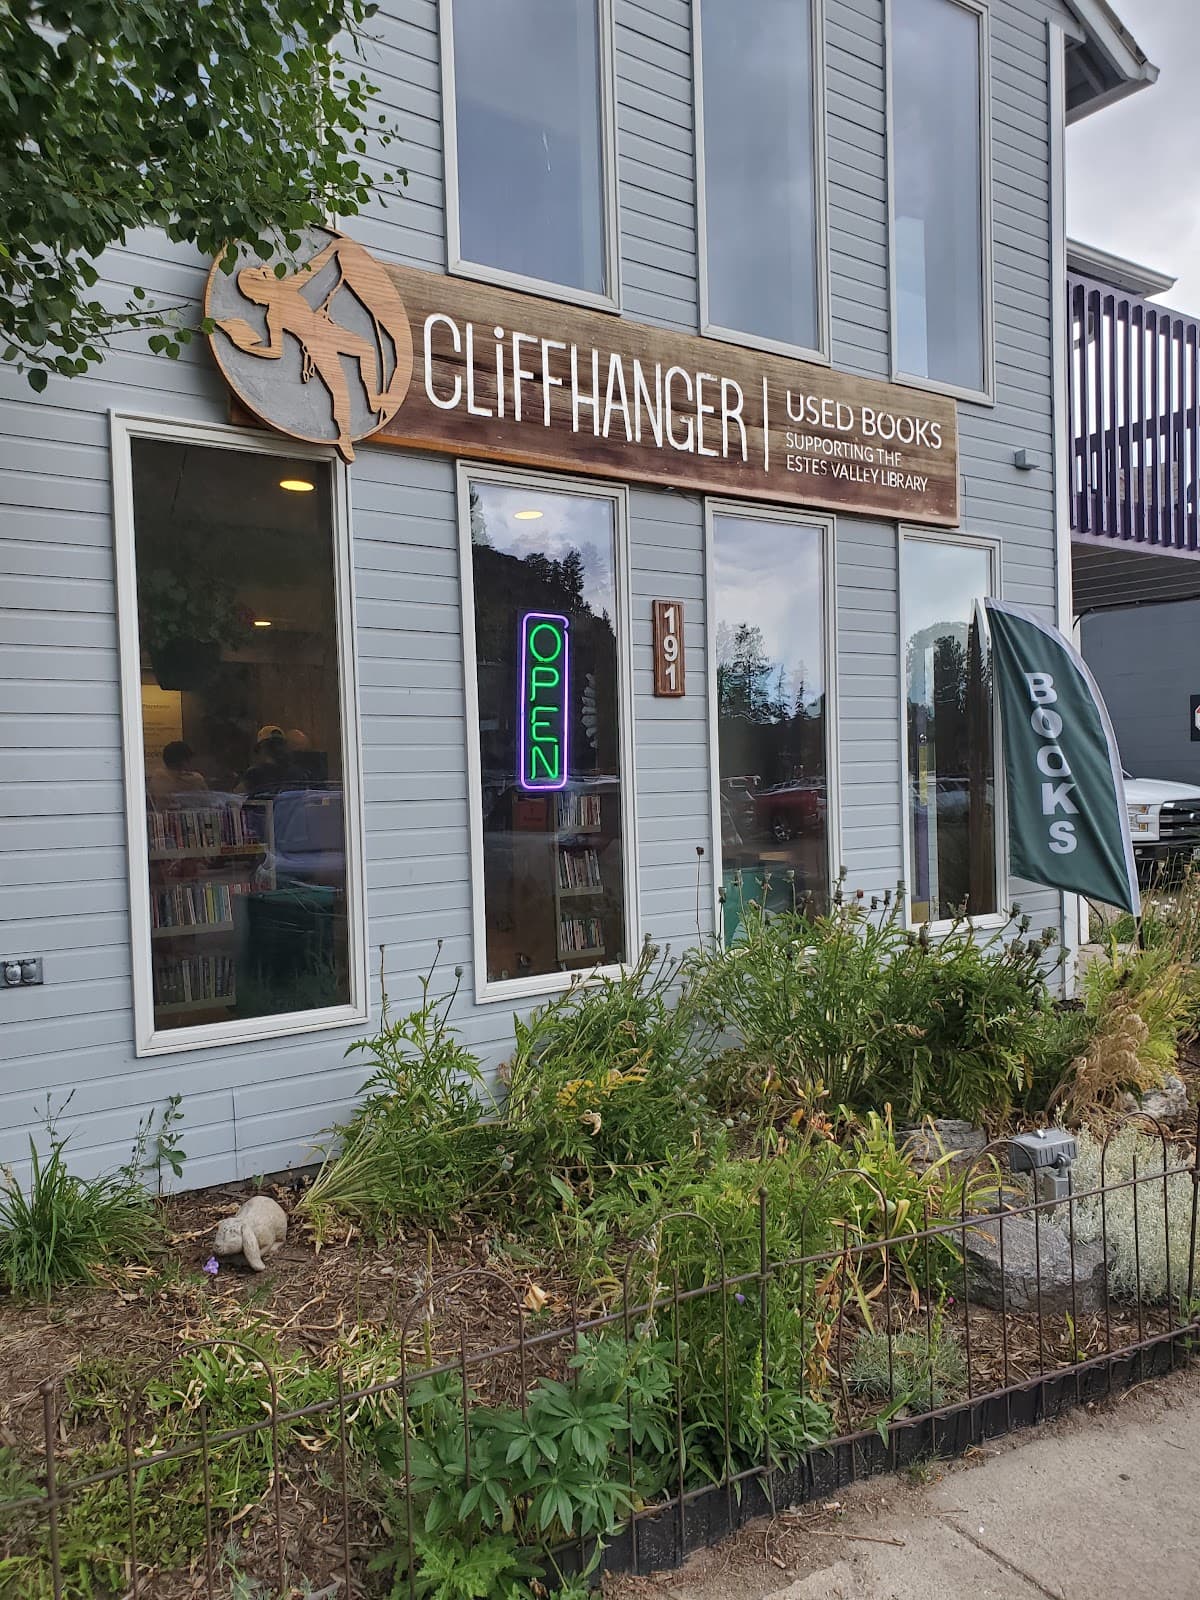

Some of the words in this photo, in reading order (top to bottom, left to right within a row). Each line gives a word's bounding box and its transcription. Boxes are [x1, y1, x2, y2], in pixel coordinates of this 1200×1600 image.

[786, 390, 854, 431] USED
[861, 407, 942, 449] BOOKS
[786, 432, 874, 463] SUPPORTING
[876, 448, 902, 467] THE
[786, 454, 828, 476] ESTES
[829, 461, 880, 484] VALLEY
[881, 470, 928, 493] LIBRARY
[663, 606, 679, 690] 191
[529, 623, 562, 780] OPEN
[1023, 672, 1079, 854] BOOKS
